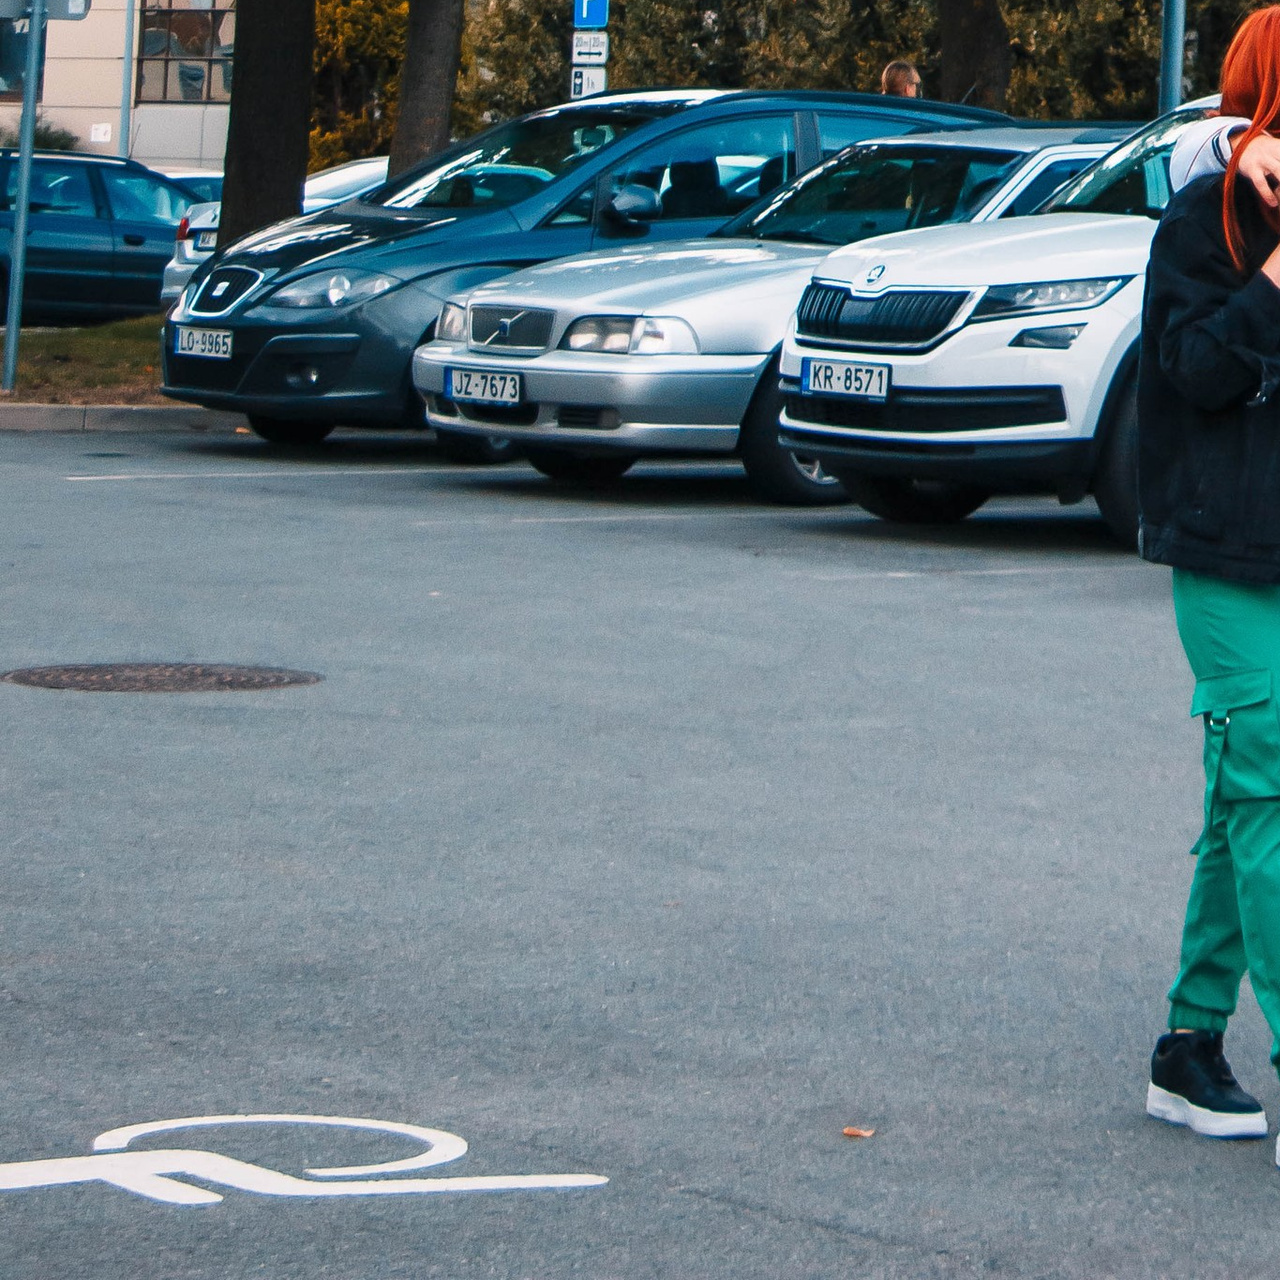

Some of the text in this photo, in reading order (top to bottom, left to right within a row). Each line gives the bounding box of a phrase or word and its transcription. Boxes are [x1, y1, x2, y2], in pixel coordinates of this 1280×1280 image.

[180, 330, 230, 355] LO-9965
[455, 373, 518, 399] JZ-7673
[812, 364, 884, 394] KR-8571
